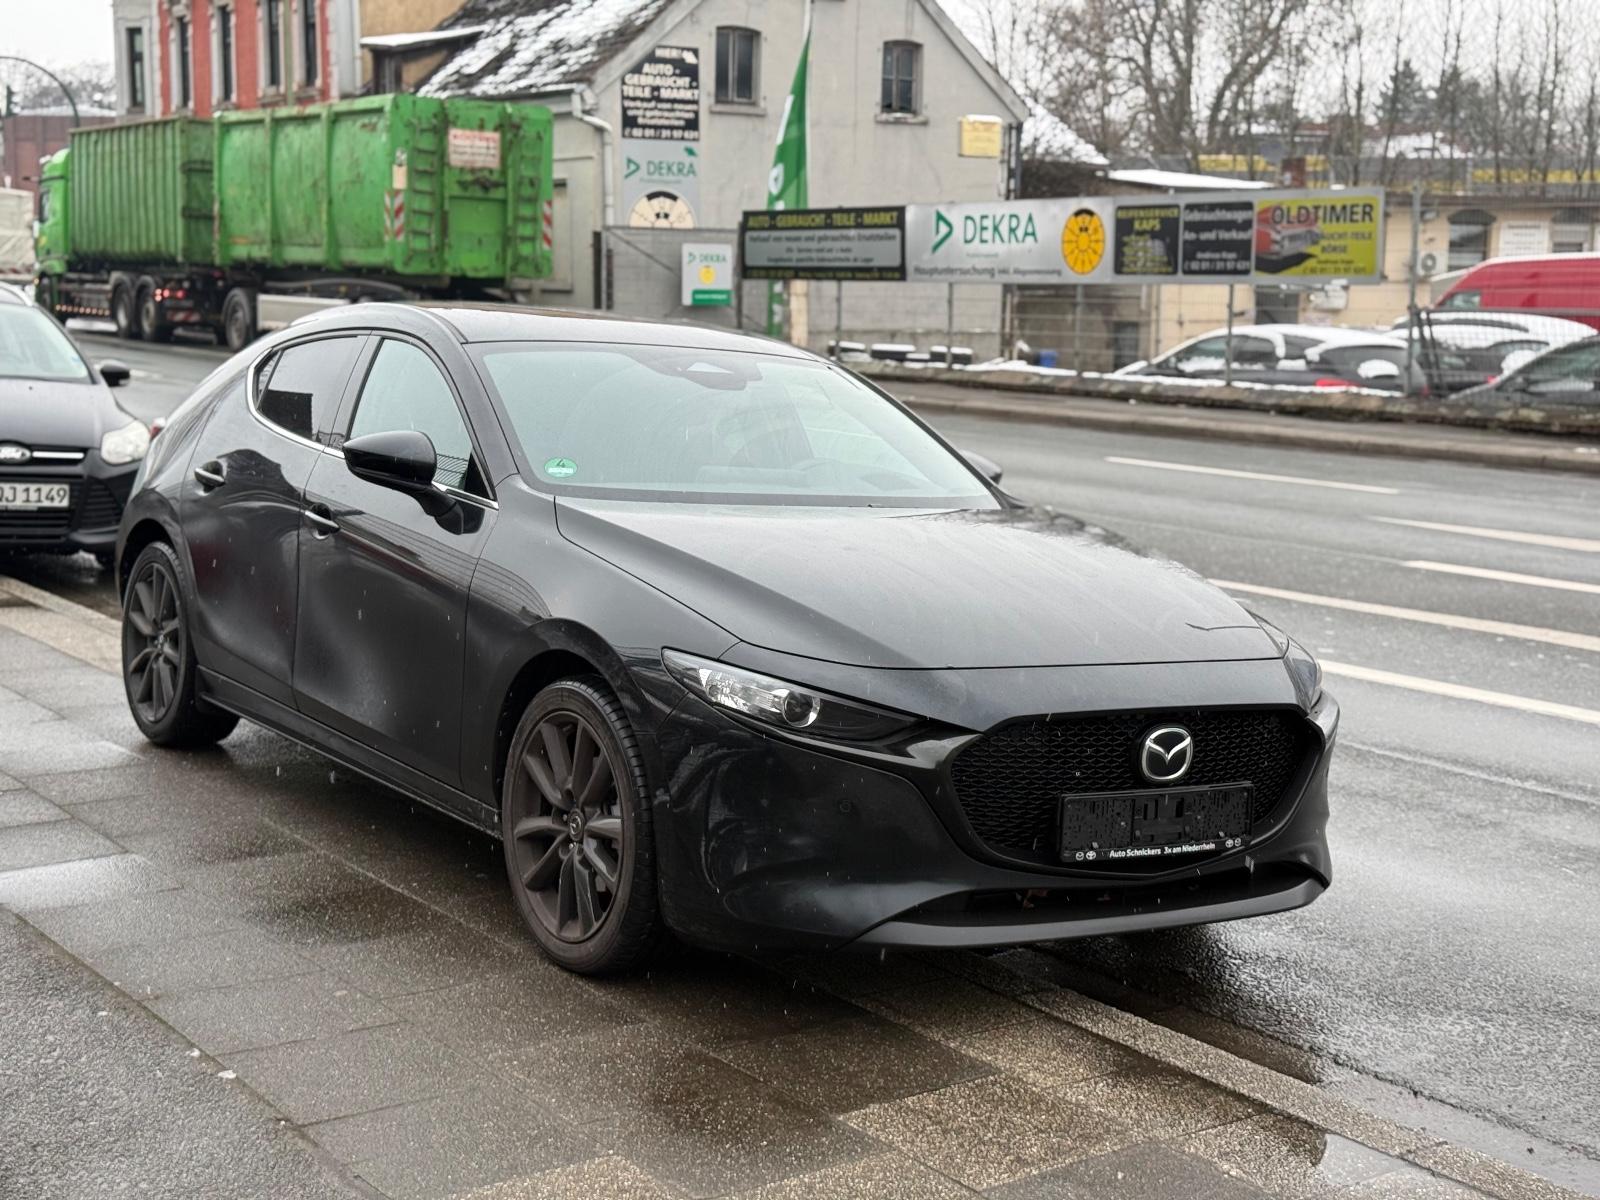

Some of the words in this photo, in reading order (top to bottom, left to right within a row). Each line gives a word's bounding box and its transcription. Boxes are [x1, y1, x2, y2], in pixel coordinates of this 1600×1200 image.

[622, 84, 652, 98] TEILE
[659, 87, 699, 100] MARKT
[646, 160, 698, 177] DEKRA
[1183, 208, 1253, 224] Gebrauchtwagen
[1271, 203, 1374, 225] OLDTIMER
[962, 212, 1038, 244] DEKRA
[1134, 218, 1161, 231] KAPS
[1199, 229, 1217, 240] und
[1218, 229, 1252, 240] Verkauf
[913, 264, 995, 279] Hauptuntersuchung
[22, 486, 68, 504] 1149
[1109, 849, 1126, 858] Auto
[1127, 847, 1161, 857] Schnickers
[1173, 846, 1182, 854] am
